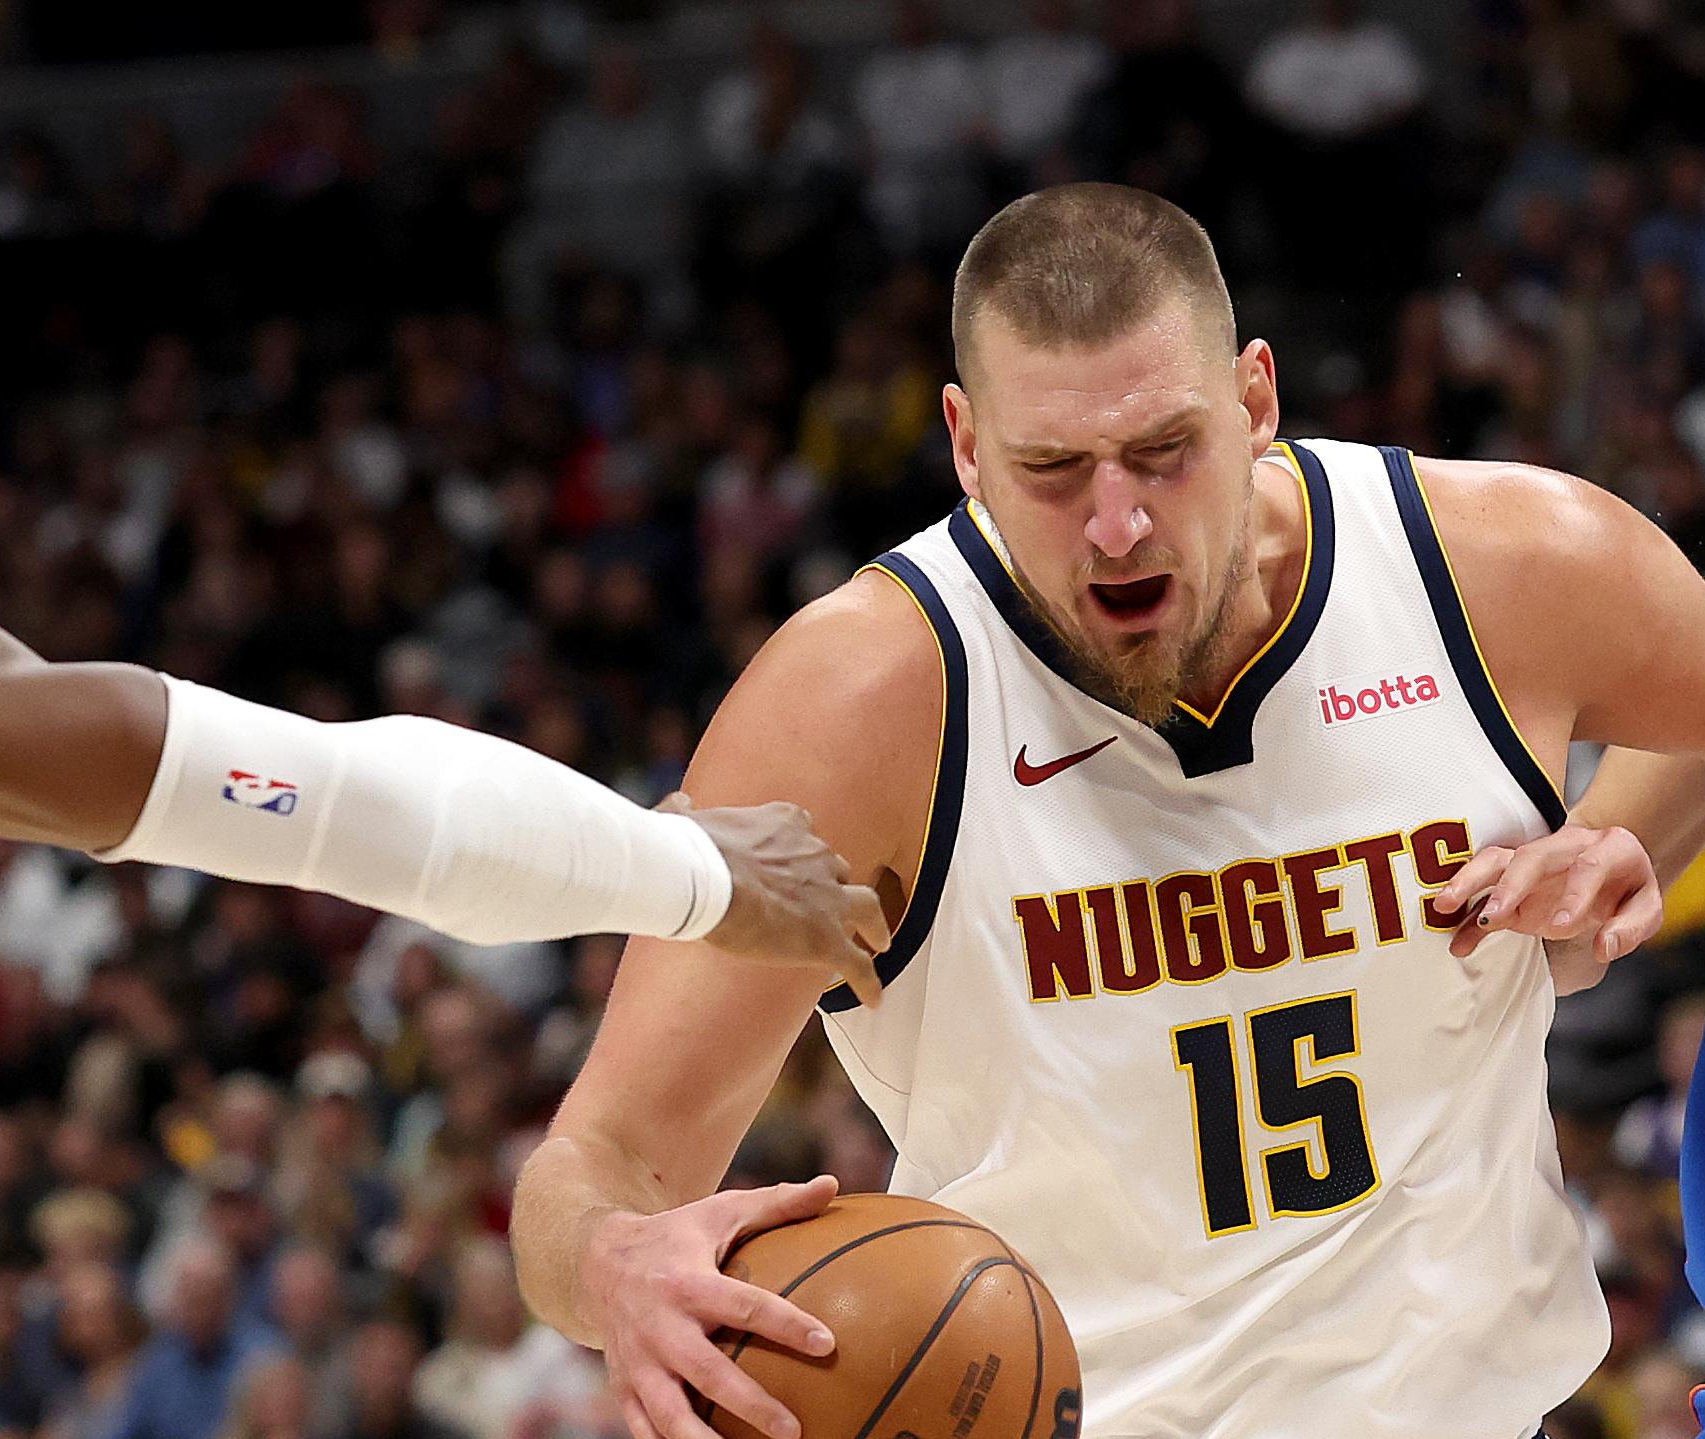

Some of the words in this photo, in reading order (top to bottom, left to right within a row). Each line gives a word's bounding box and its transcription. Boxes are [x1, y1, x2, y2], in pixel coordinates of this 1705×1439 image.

[1318, 675, 1441, 724] ibotta
[1011, 818, 1475, 1003] NUGGETS
[1170, 989, 1382, 1240] 15
